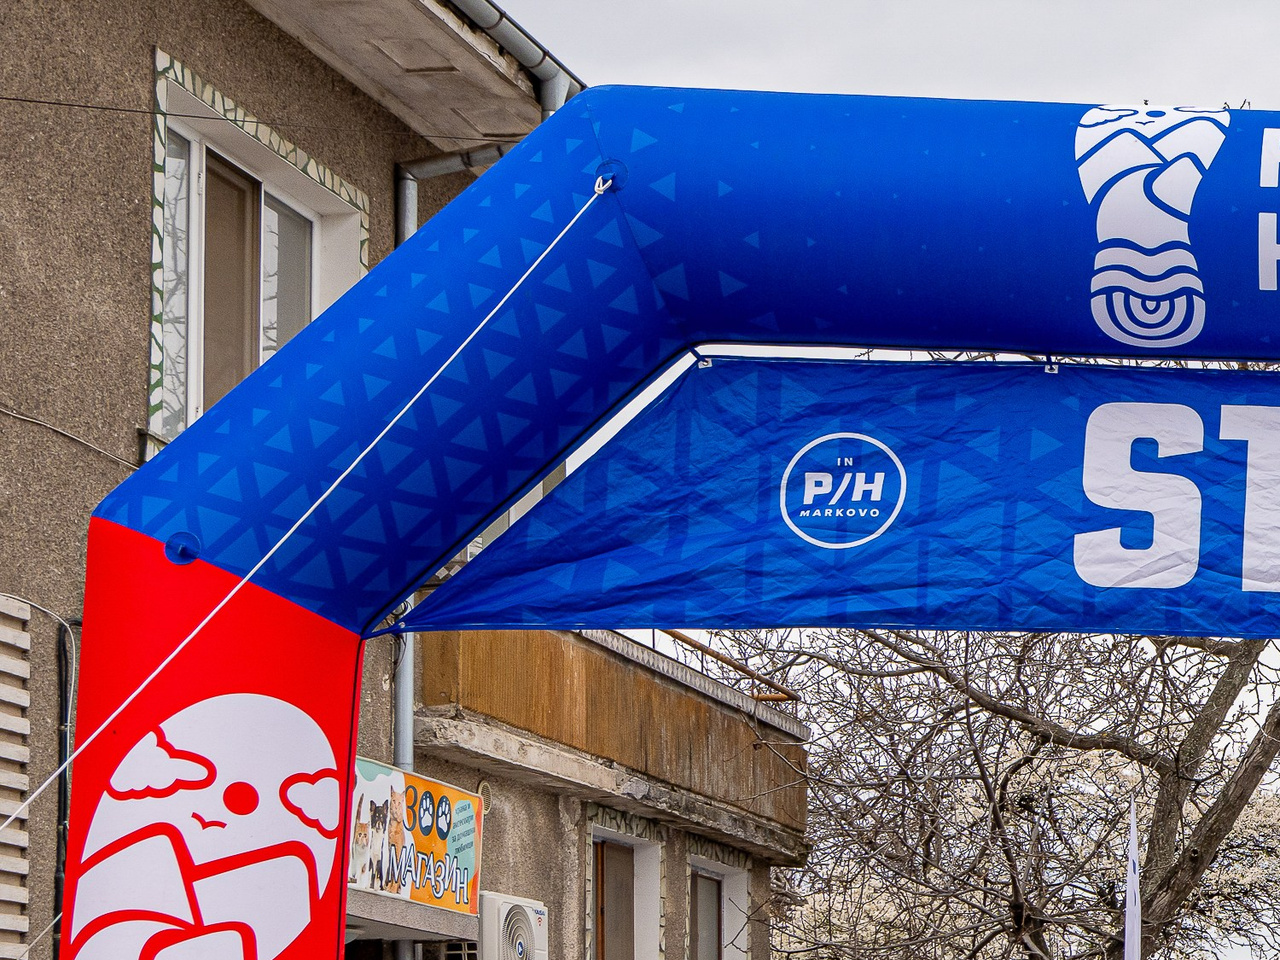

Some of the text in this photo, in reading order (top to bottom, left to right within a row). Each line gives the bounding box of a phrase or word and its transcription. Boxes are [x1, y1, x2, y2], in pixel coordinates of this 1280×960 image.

[836, 457, 854, 467] IN
[802, 471, 886, 506] P/H
[799, 508, 881, 518] MARKOVO
[388, 844, 469, 904] МАГАЗИН
